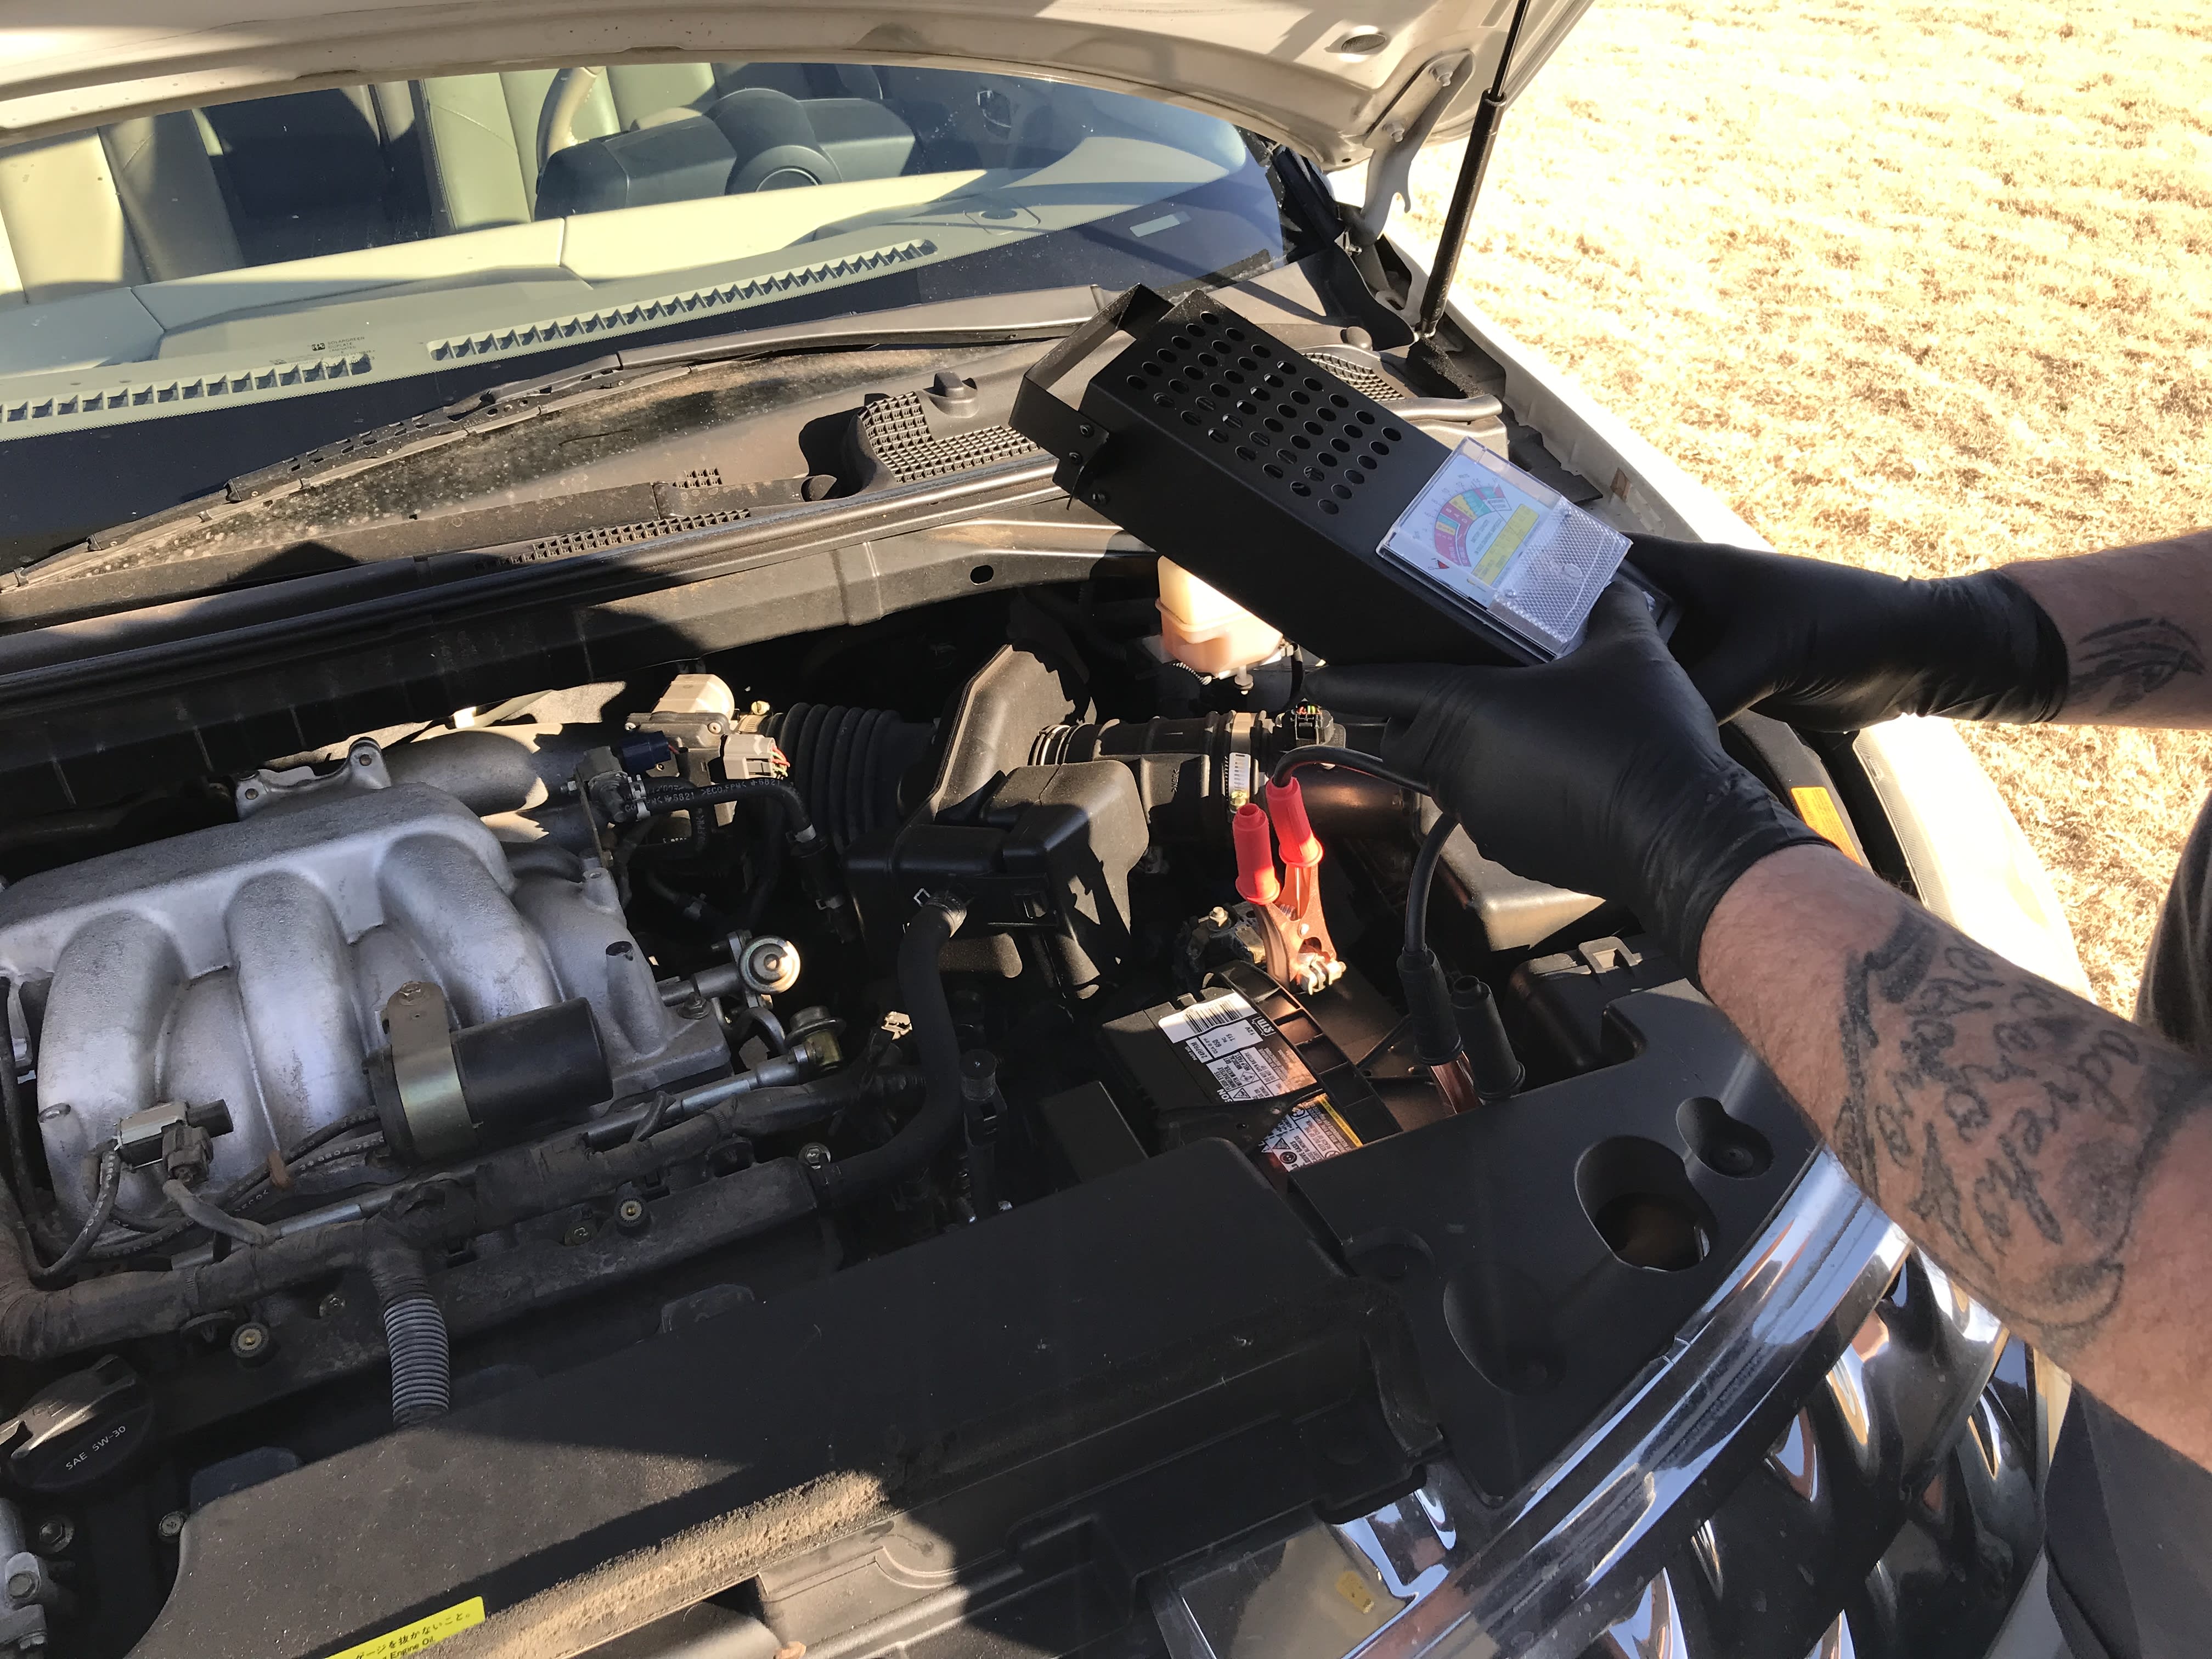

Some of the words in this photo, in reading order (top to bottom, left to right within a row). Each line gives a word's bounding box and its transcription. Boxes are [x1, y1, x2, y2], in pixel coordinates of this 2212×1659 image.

[1226, 1032, 1235, 1041] 115
[1244, 1025, 1255, 1036] 12V
[66, 1452, 88, 1470] SAE
[92, 1426, 126, 1452] 5W-30
[390, 1644, 419, 1659] Engine
